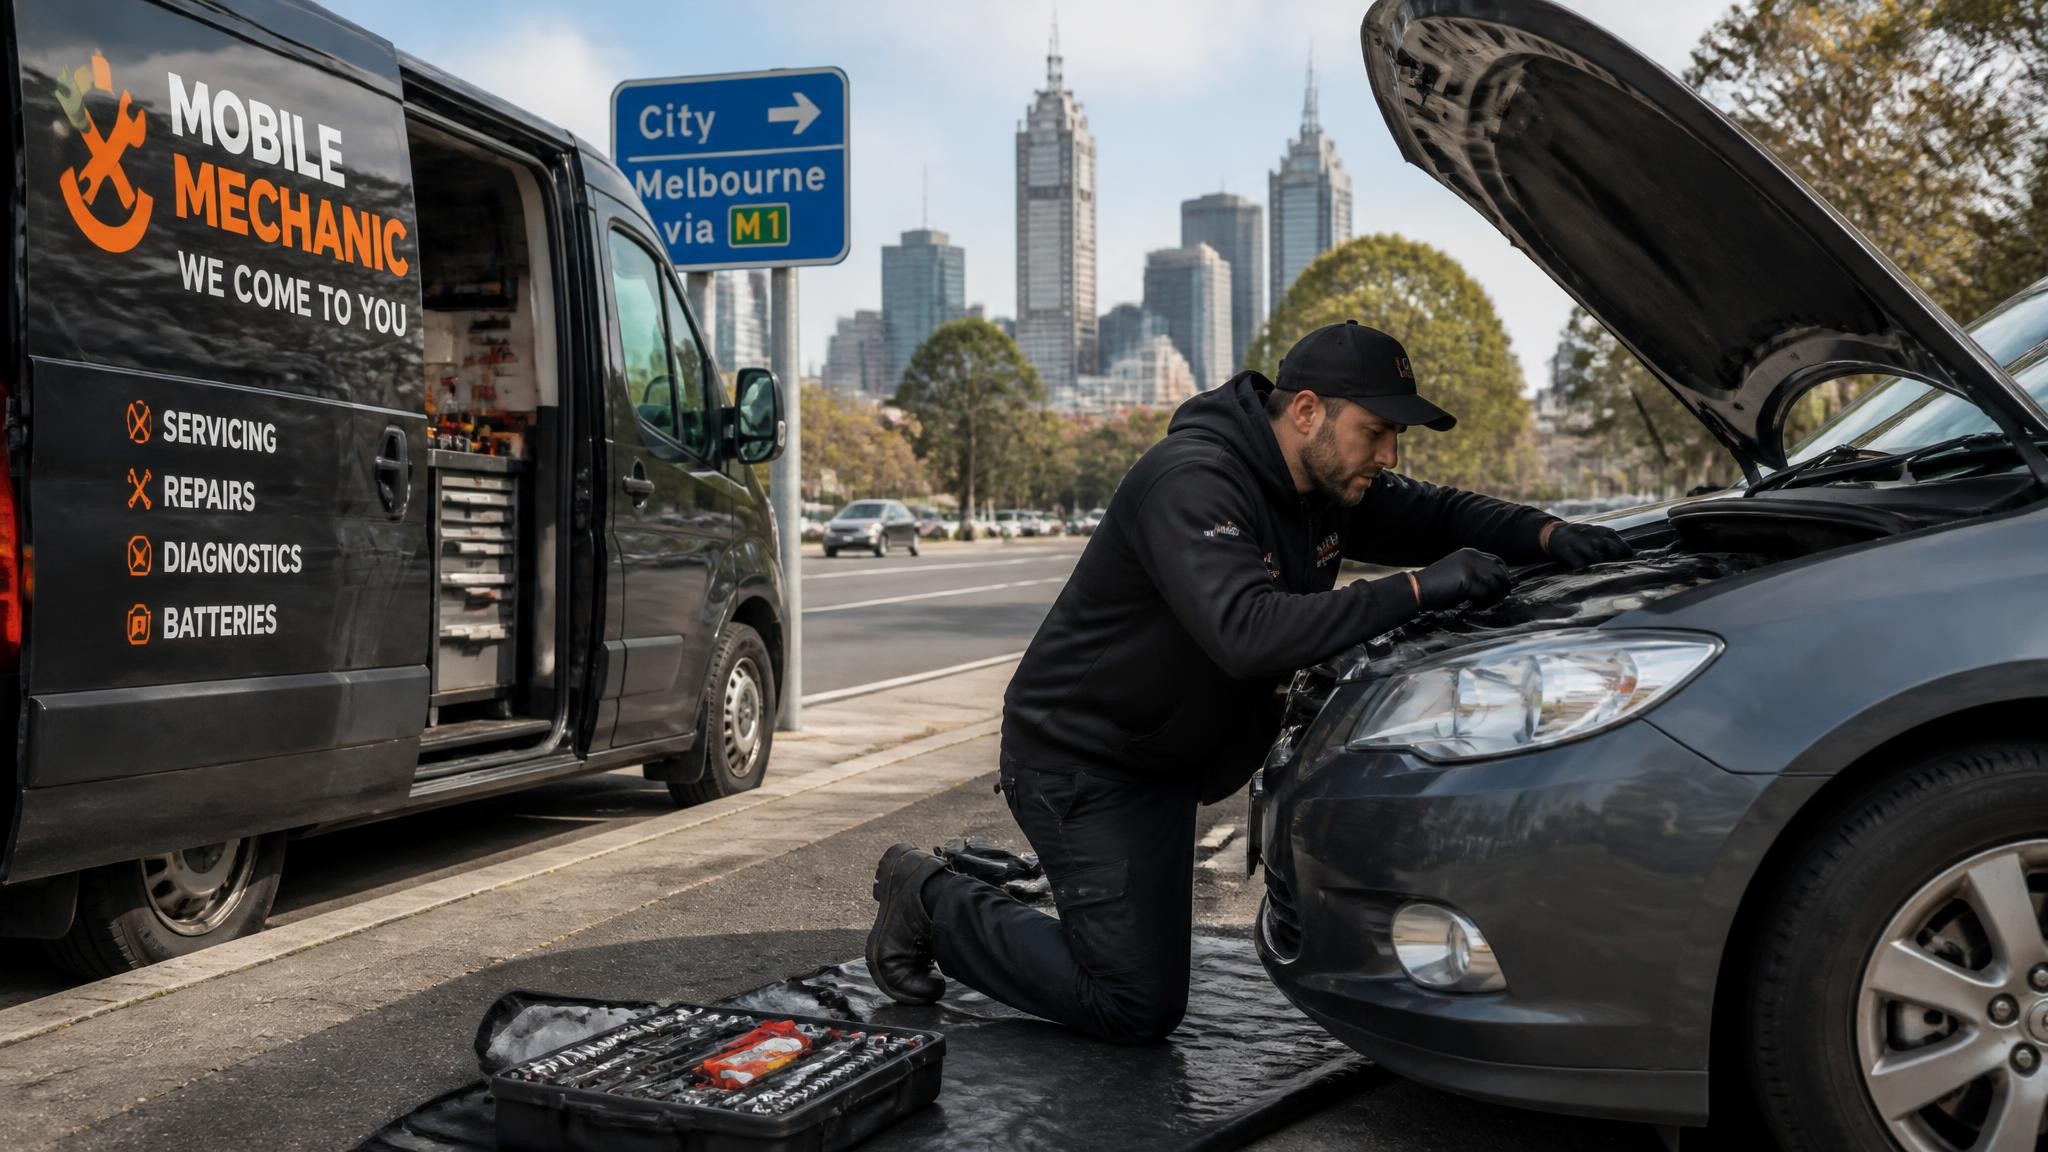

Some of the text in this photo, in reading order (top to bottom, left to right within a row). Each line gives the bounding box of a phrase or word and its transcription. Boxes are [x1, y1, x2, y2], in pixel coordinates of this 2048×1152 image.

[168, 72, 345, 188] MOBILE
[639, 103, 715, 144] City
[635, 166, 826, 200] Melbourne
[173, 153, 409, 277] MECHANIC
[663, 211, 779, 245] via M1
[178, 251, 407, 337] WE COME TO YOU
[163, 410, 276, 453] SERVICING
[164, 475, 255, 511] REPAIRS
[164, 541, 302, 574] DIAGNOSTICS
[163, 604, 277, 639] BATTERIES
